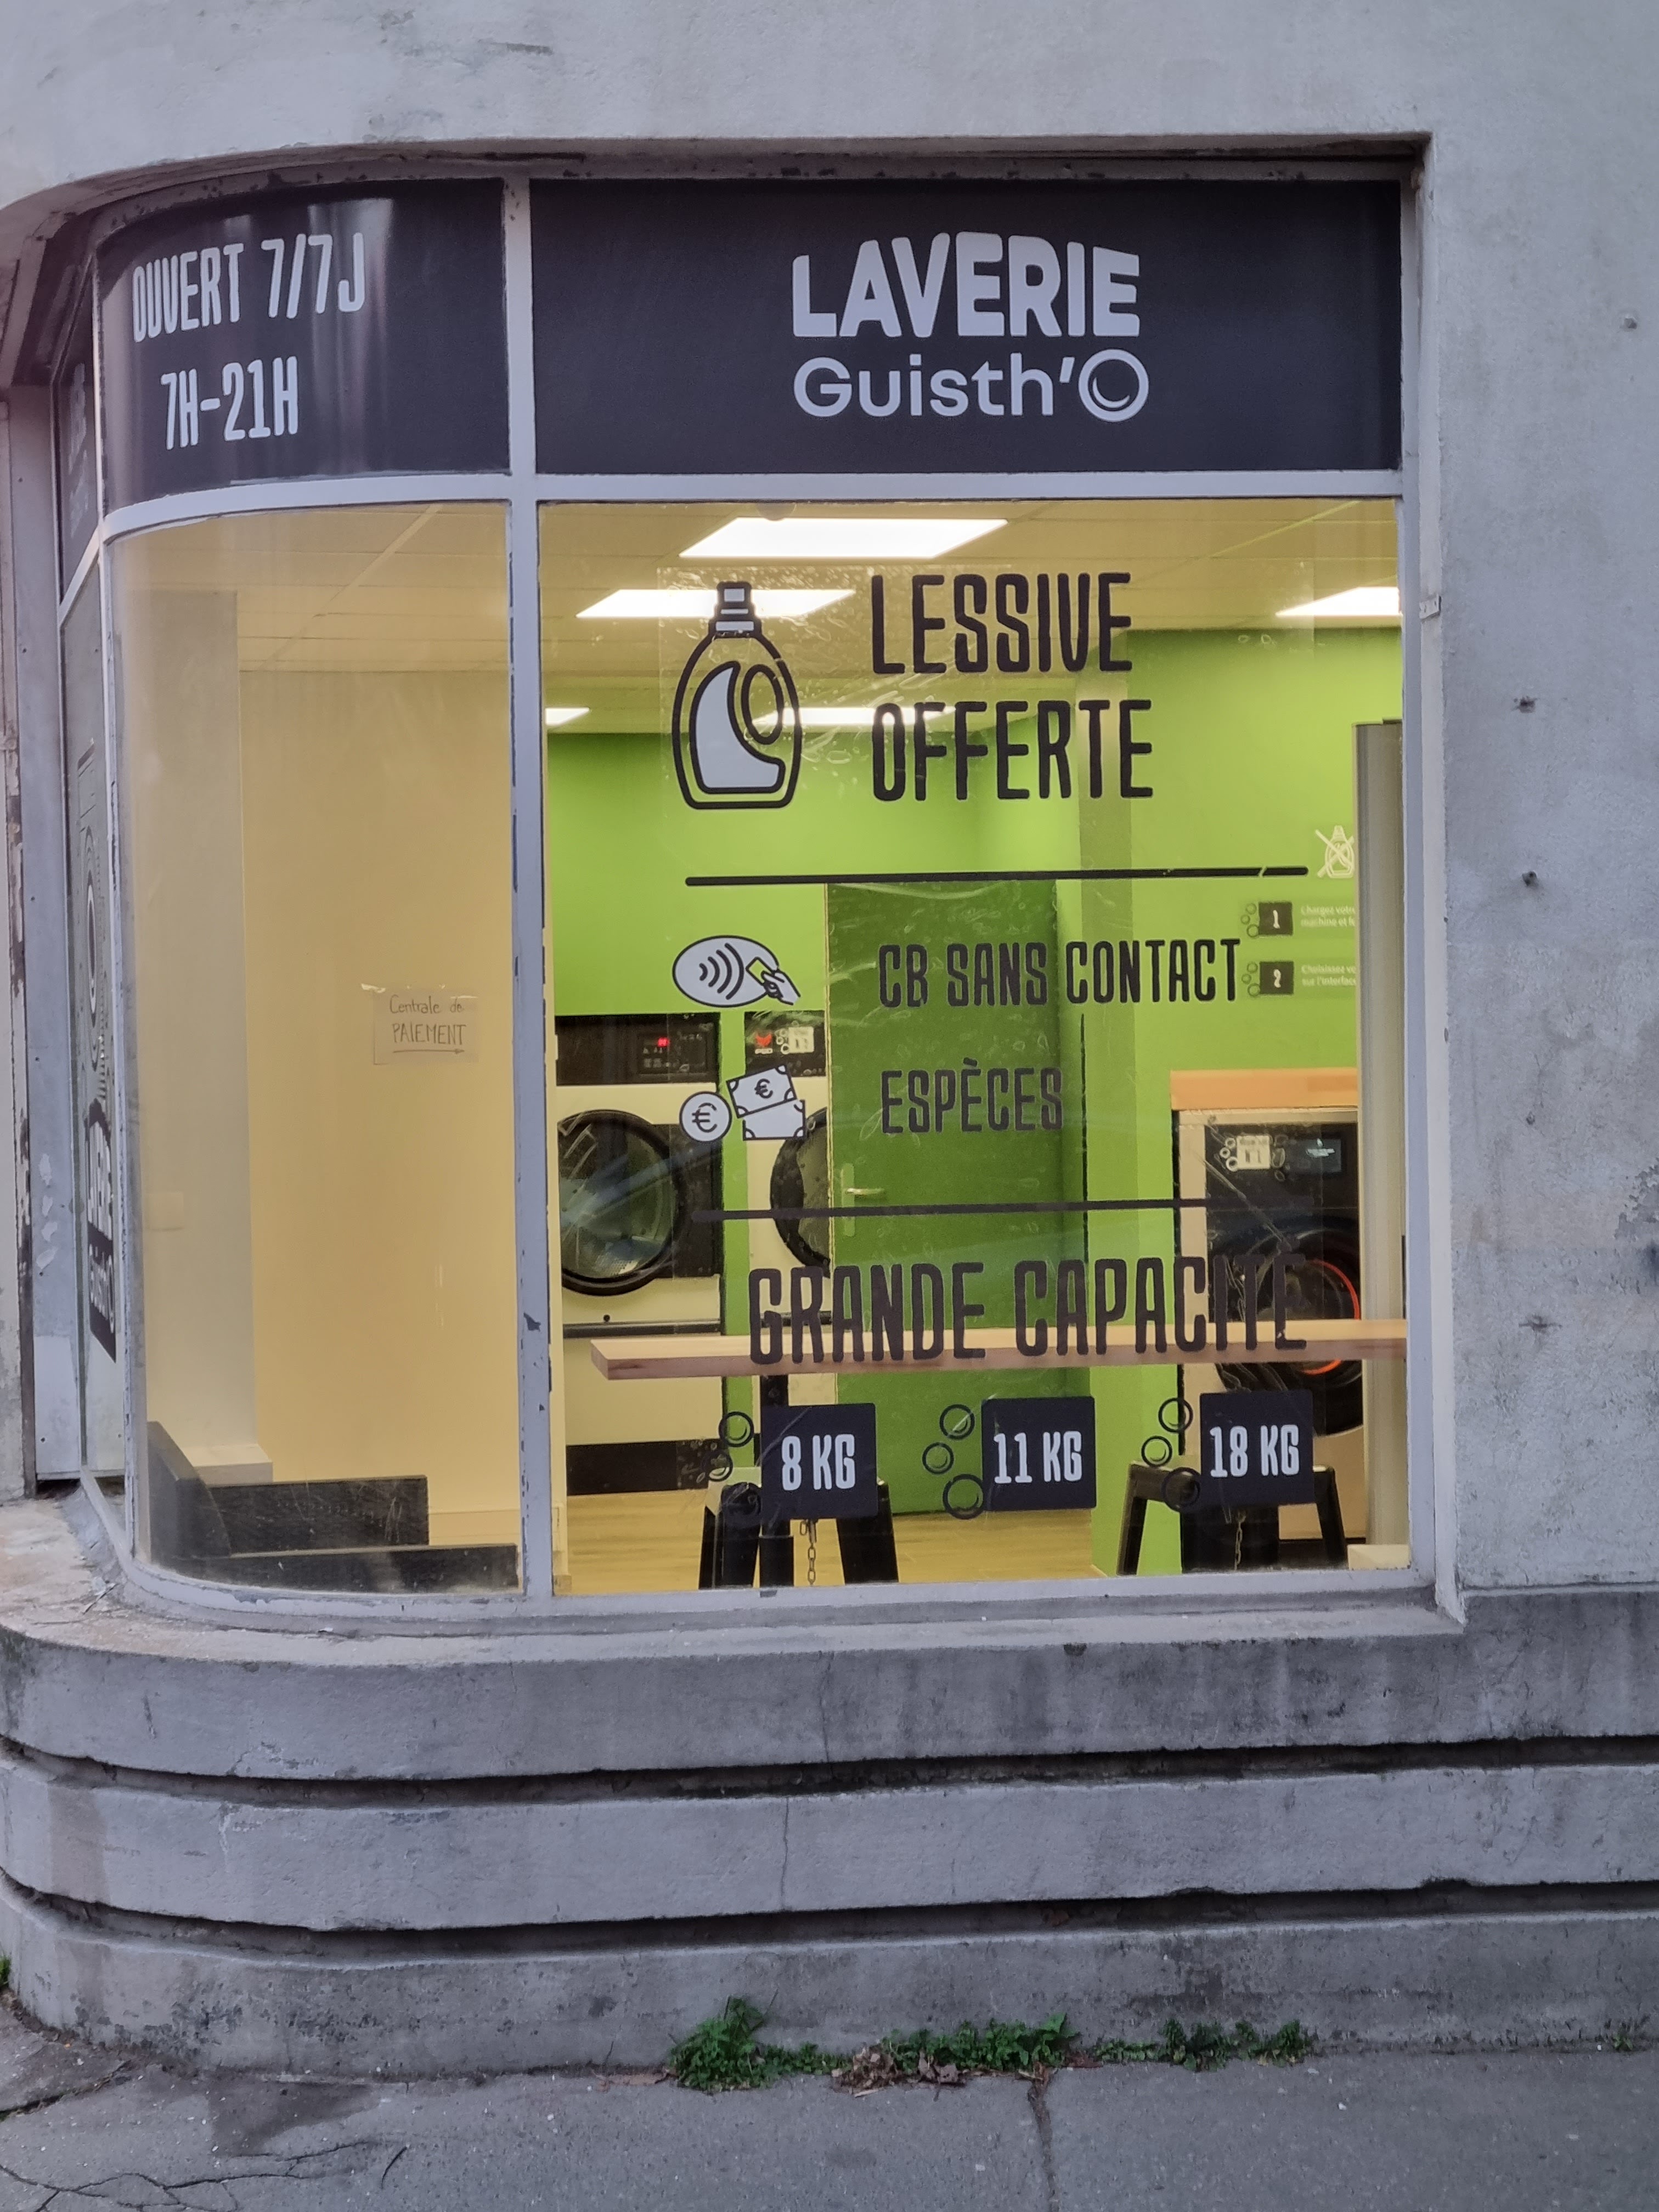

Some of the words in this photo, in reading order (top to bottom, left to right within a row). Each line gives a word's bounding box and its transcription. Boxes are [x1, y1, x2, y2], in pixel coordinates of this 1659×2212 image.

[132, 242, 245, 343] OUVERT
[261, 232, 366, 319] 7/7J
[792, 231, 1140, 338] LAVERIE
[160, 356, 299, 450] 7H-21H
[793, 348, 1149, 422] Guisth'O
[871, 572, 1132, 674] LESSIVE
[871, 699, 1154, 802] OFFERTE
[1272, 909, 1280, 929] 1
[390, 994, 441, 1014] Centrale
[449, 997, 465, 1013] de
[878, 944, 928, 1008] CB
[946, 942, 1048, 1007] SANS
[1065, 939, 1240, 1005] CONTACT
[392, 1021, 467, 1046] PAIEMENT
[881, 1057, 1064, 1135] ESPÈCES
[748, 1261, 986, 1366] GRANDE
[781, 1435, 802, 1491] 8
[812, 1433, 856, 1490] KG
[994, 1432, 1032, 1484] 11
[1043, 1430, 1082, 1482] KG
[1210, 1426, 1248, 1478] 18
[1260, 1424, 1300, 1476] KG
